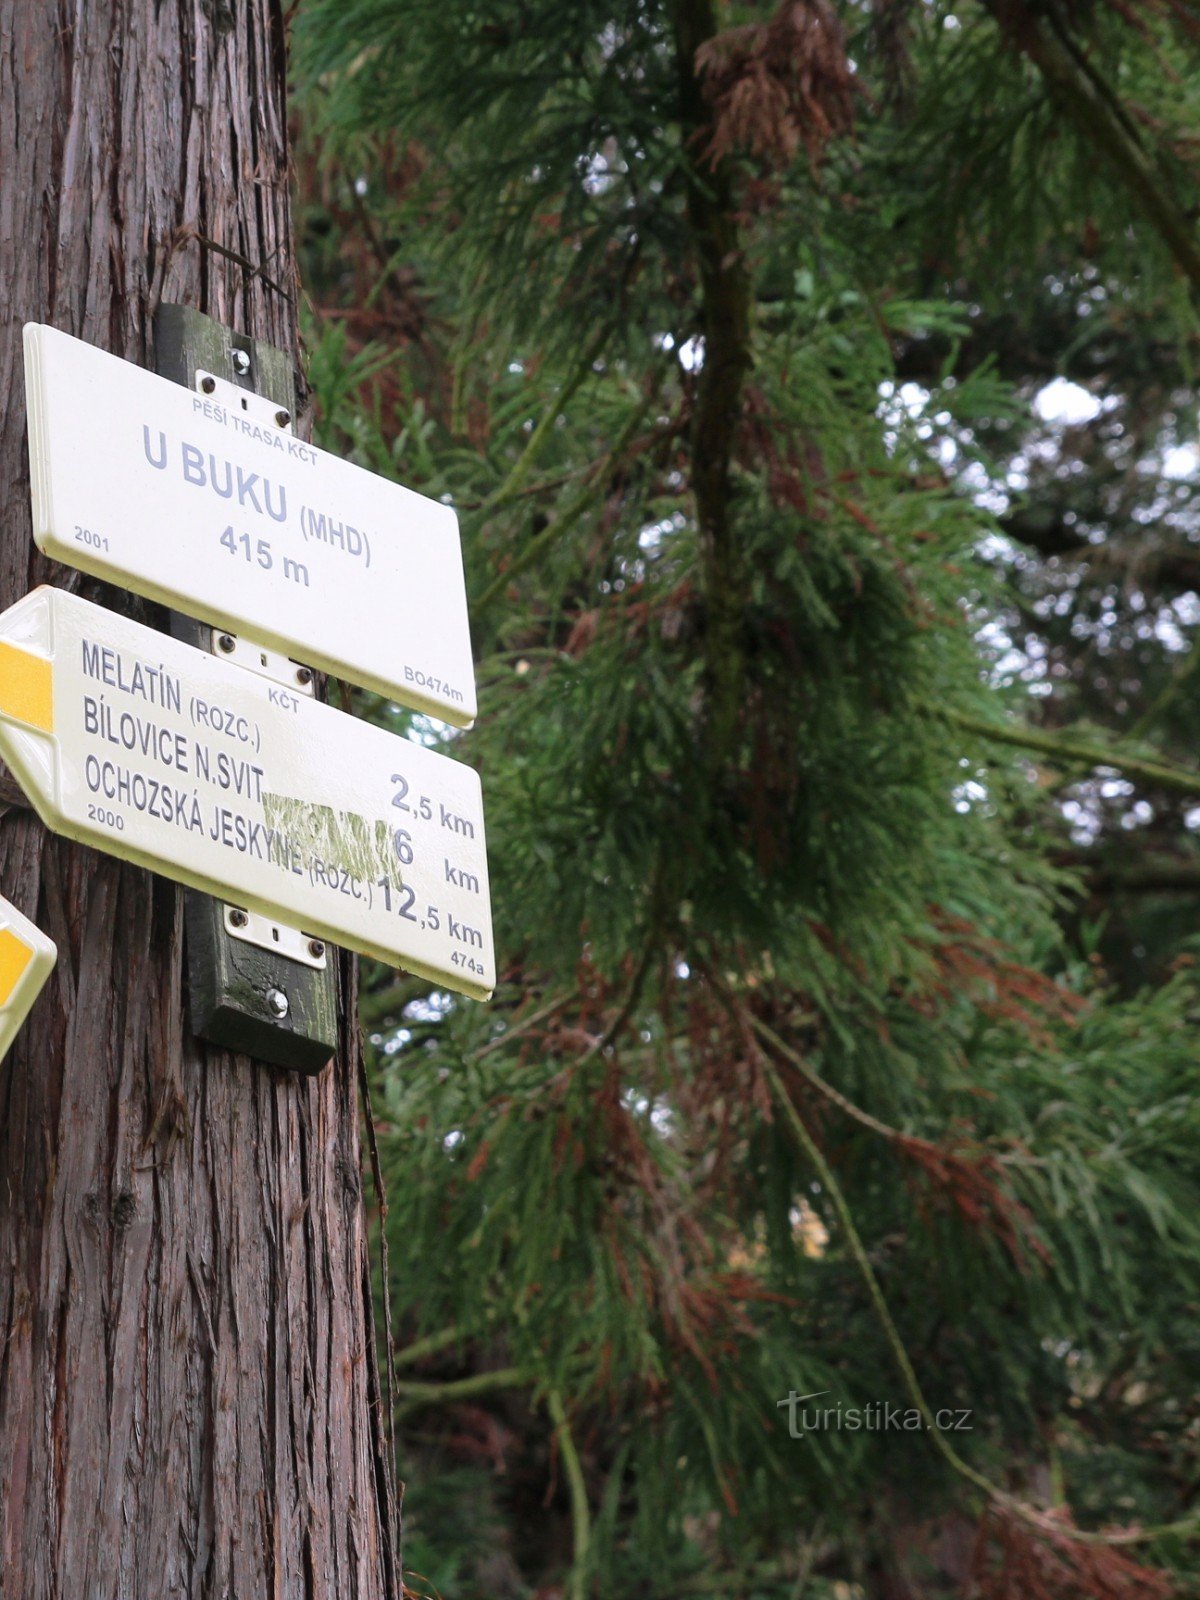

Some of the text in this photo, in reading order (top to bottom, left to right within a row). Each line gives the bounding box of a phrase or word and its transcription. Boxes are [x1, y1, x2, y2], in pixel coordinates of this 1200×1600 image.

[193, 397, 317, 465] PĚŠÍ TRASA KČT
[143, 424, 371, 568] U BUKU (MHD)
[74, 525, 110, 553] 2001
[220, 526, 309, 587] 415 m
[268, 687, 299, 714] KČT
[82, 638, 475, 839] MELATÍN (ROZC.) 2,5 km
[84, 694, 189, 773] BÍLOVICE
[394, 828, 414, 865] 6
[444, 858, 479, 894] km
[88, 803, 124, 831] 2000
[85, 754, 204, 835] OCHOZSKÁ
[308, 856, 372, 910] (ROZC.)
[378, 875, 440, 931] 12,5
[448, 913, 483, 949] km
[451, 951, 484, 976] 474a
